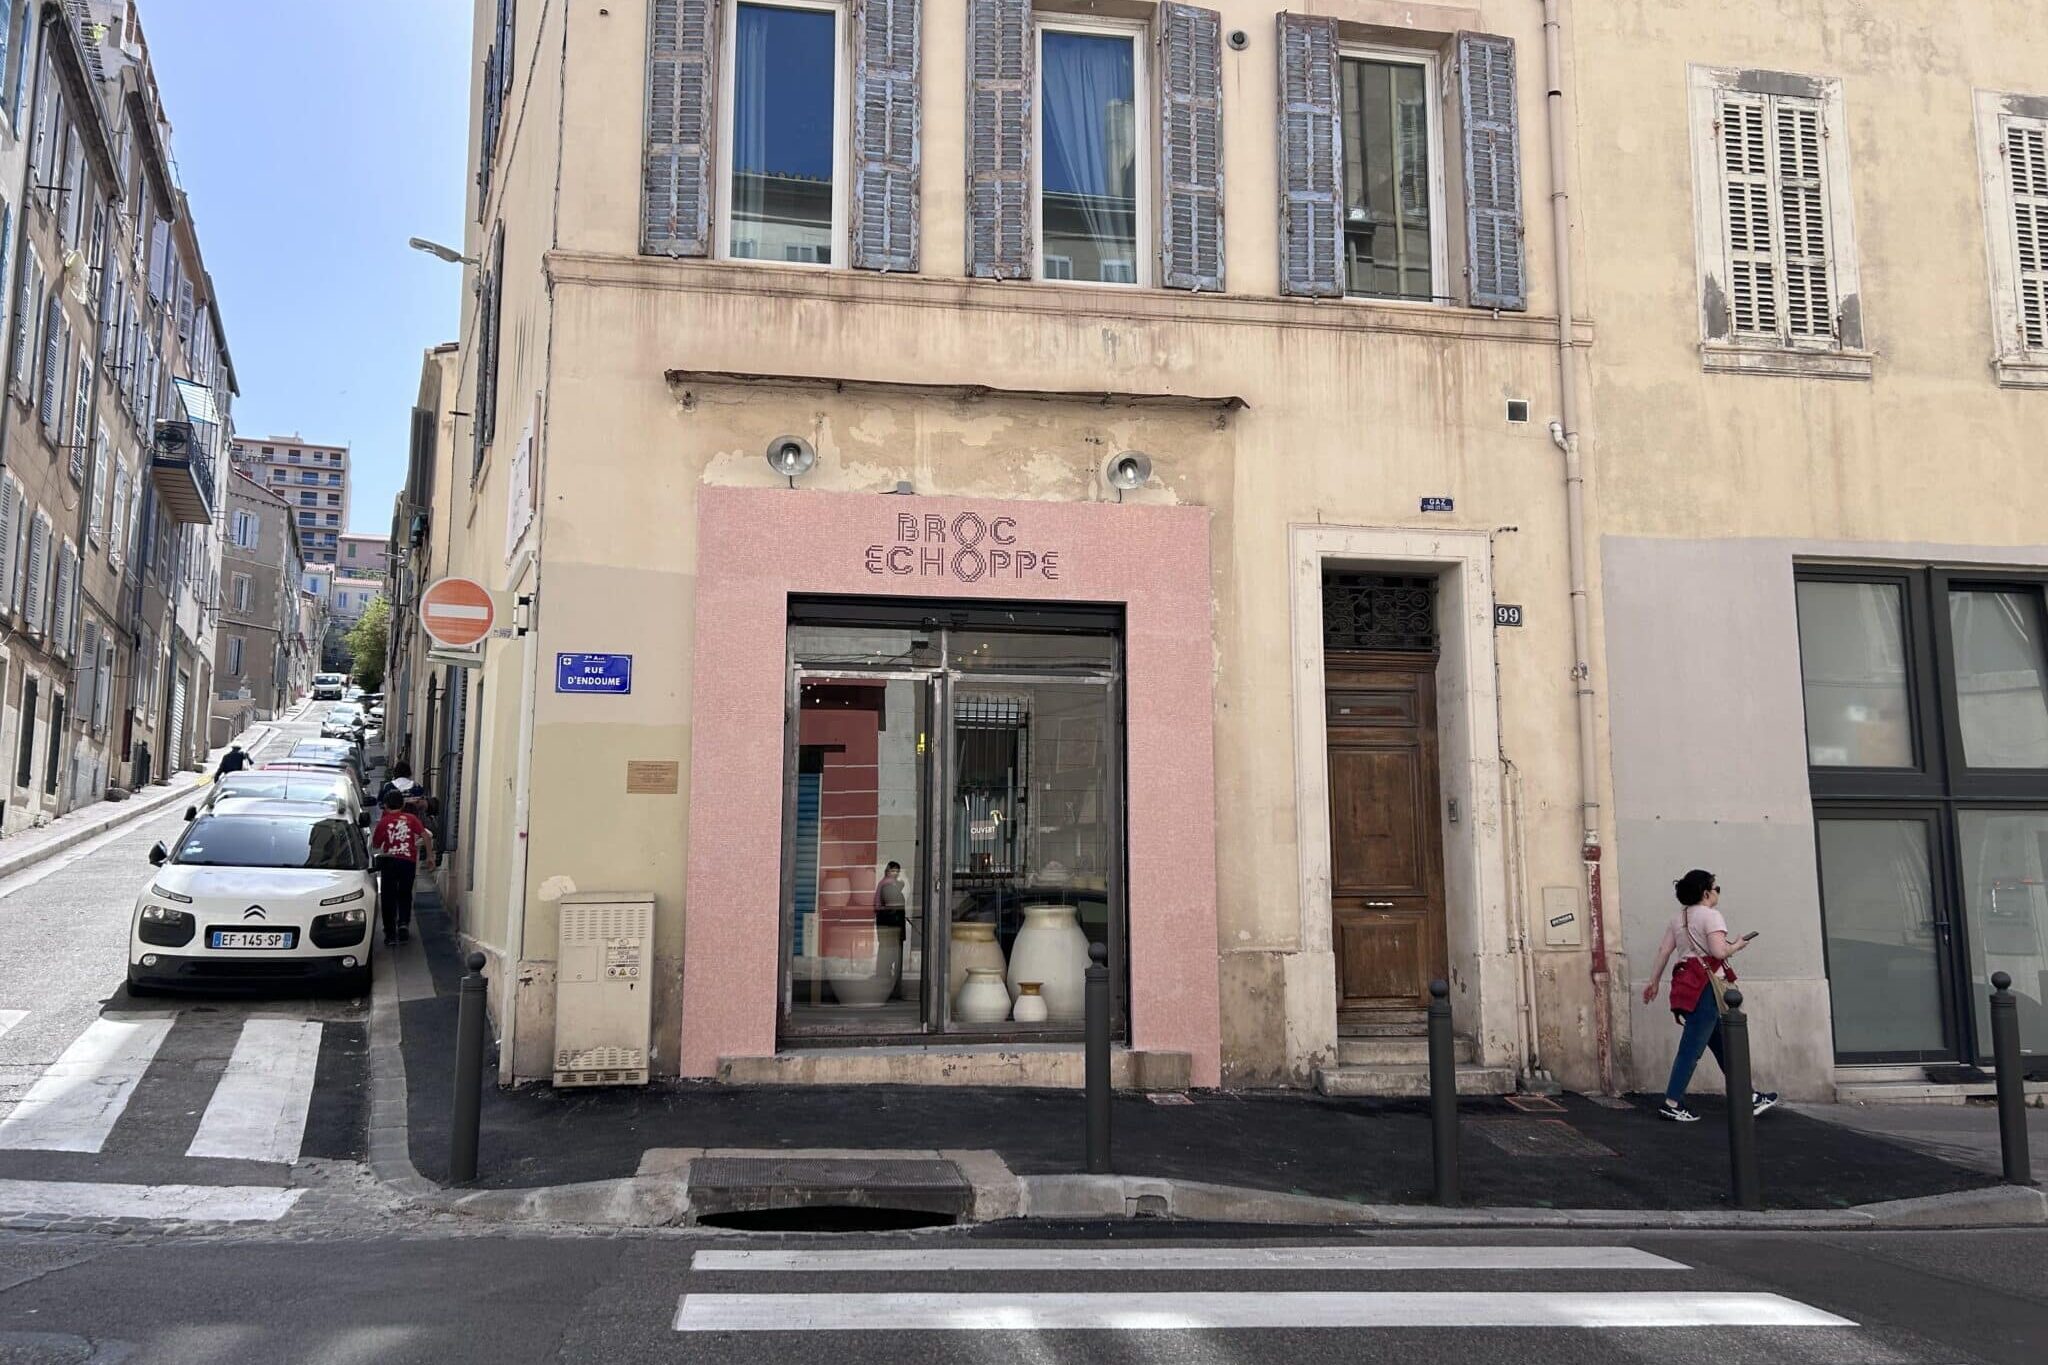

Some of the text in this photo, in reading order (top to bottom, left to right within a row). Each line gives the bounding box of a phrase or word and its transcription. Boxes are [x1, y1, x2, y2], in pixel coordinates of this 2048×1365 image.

[1429, 498, 1446, 506] GAZ
[897, 511, 1017, 547] BROC
[865, 545, 1059, 583] ECHOPPE
[1498, 607, 1519, 623] 99
[584, 666, 605, 674] RUE
[567, 676, 621, 686] D'ENDOUME
[970, 826, 996, 834] OUVERT
